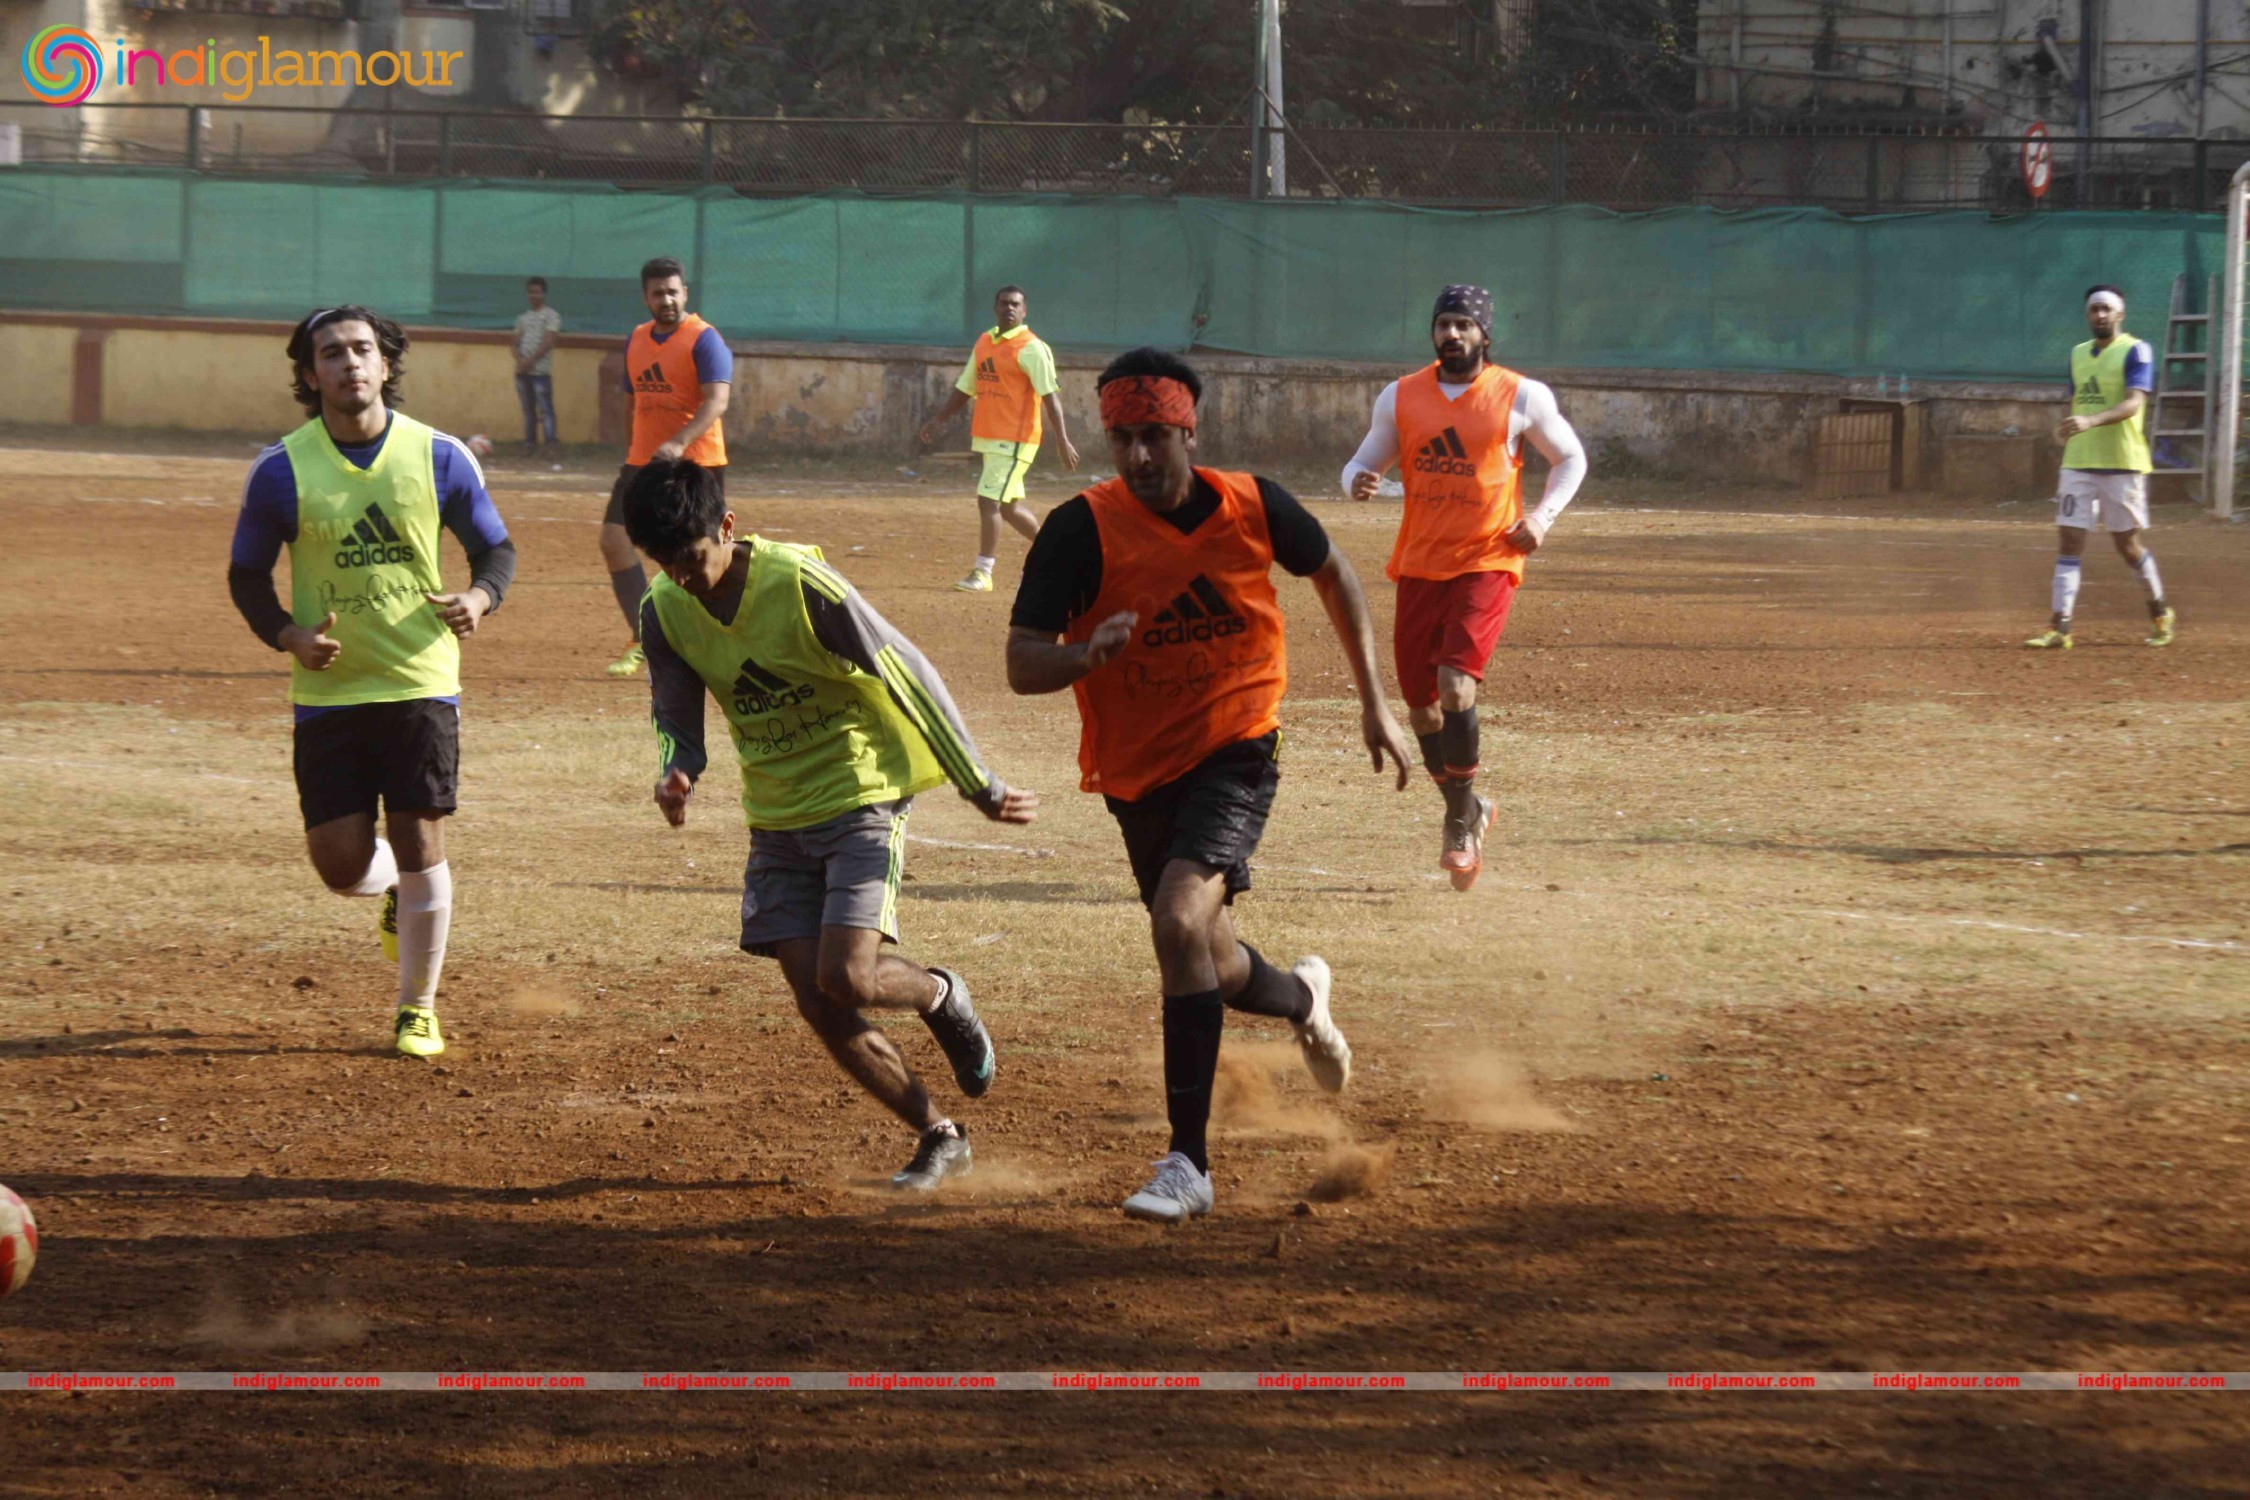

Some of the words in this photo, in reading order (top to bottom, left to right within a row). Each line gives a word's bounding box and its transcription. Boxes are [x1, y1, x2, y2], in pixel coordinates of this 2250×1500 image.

[1415, 454, 1476, 477] adidas
[335, 541, 415, 569] adidas
[1142, 615, 1248, 648] adidas
